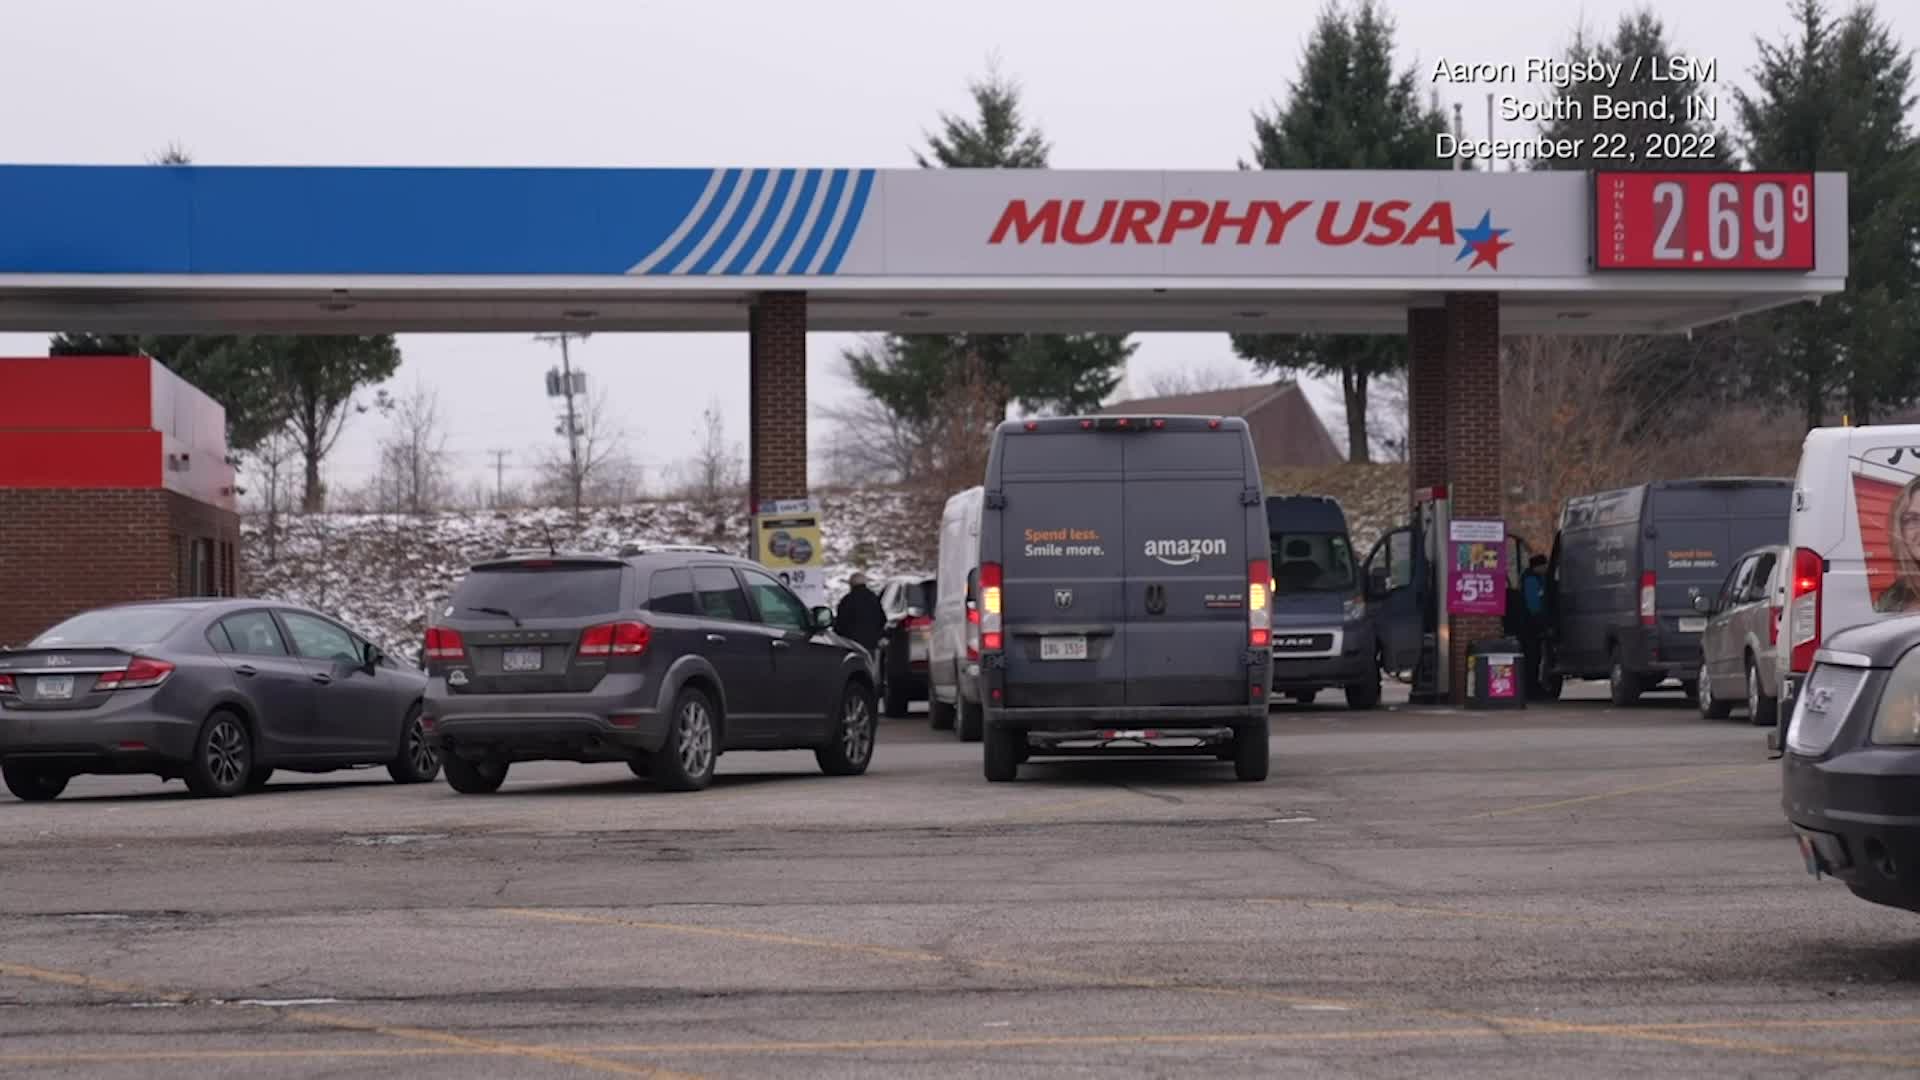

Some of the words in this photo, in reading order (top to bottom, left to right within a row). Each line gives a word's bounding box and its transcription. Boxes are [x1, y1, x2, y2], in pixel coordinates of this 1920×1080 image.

[987, 200, 1313, 245] MURPHY
[1315, 200, 1456, 246] USA
[1613, 180, 1625, 262] UNLEADED
[1024, 528, 1066, 543] Spend
[1070, 528, 1100, 540] less.
[1025, 544, 1063, 557] Smile
[1066, 546, 1104, 556] more.
[1144, 539, 1227, 556] amazon
